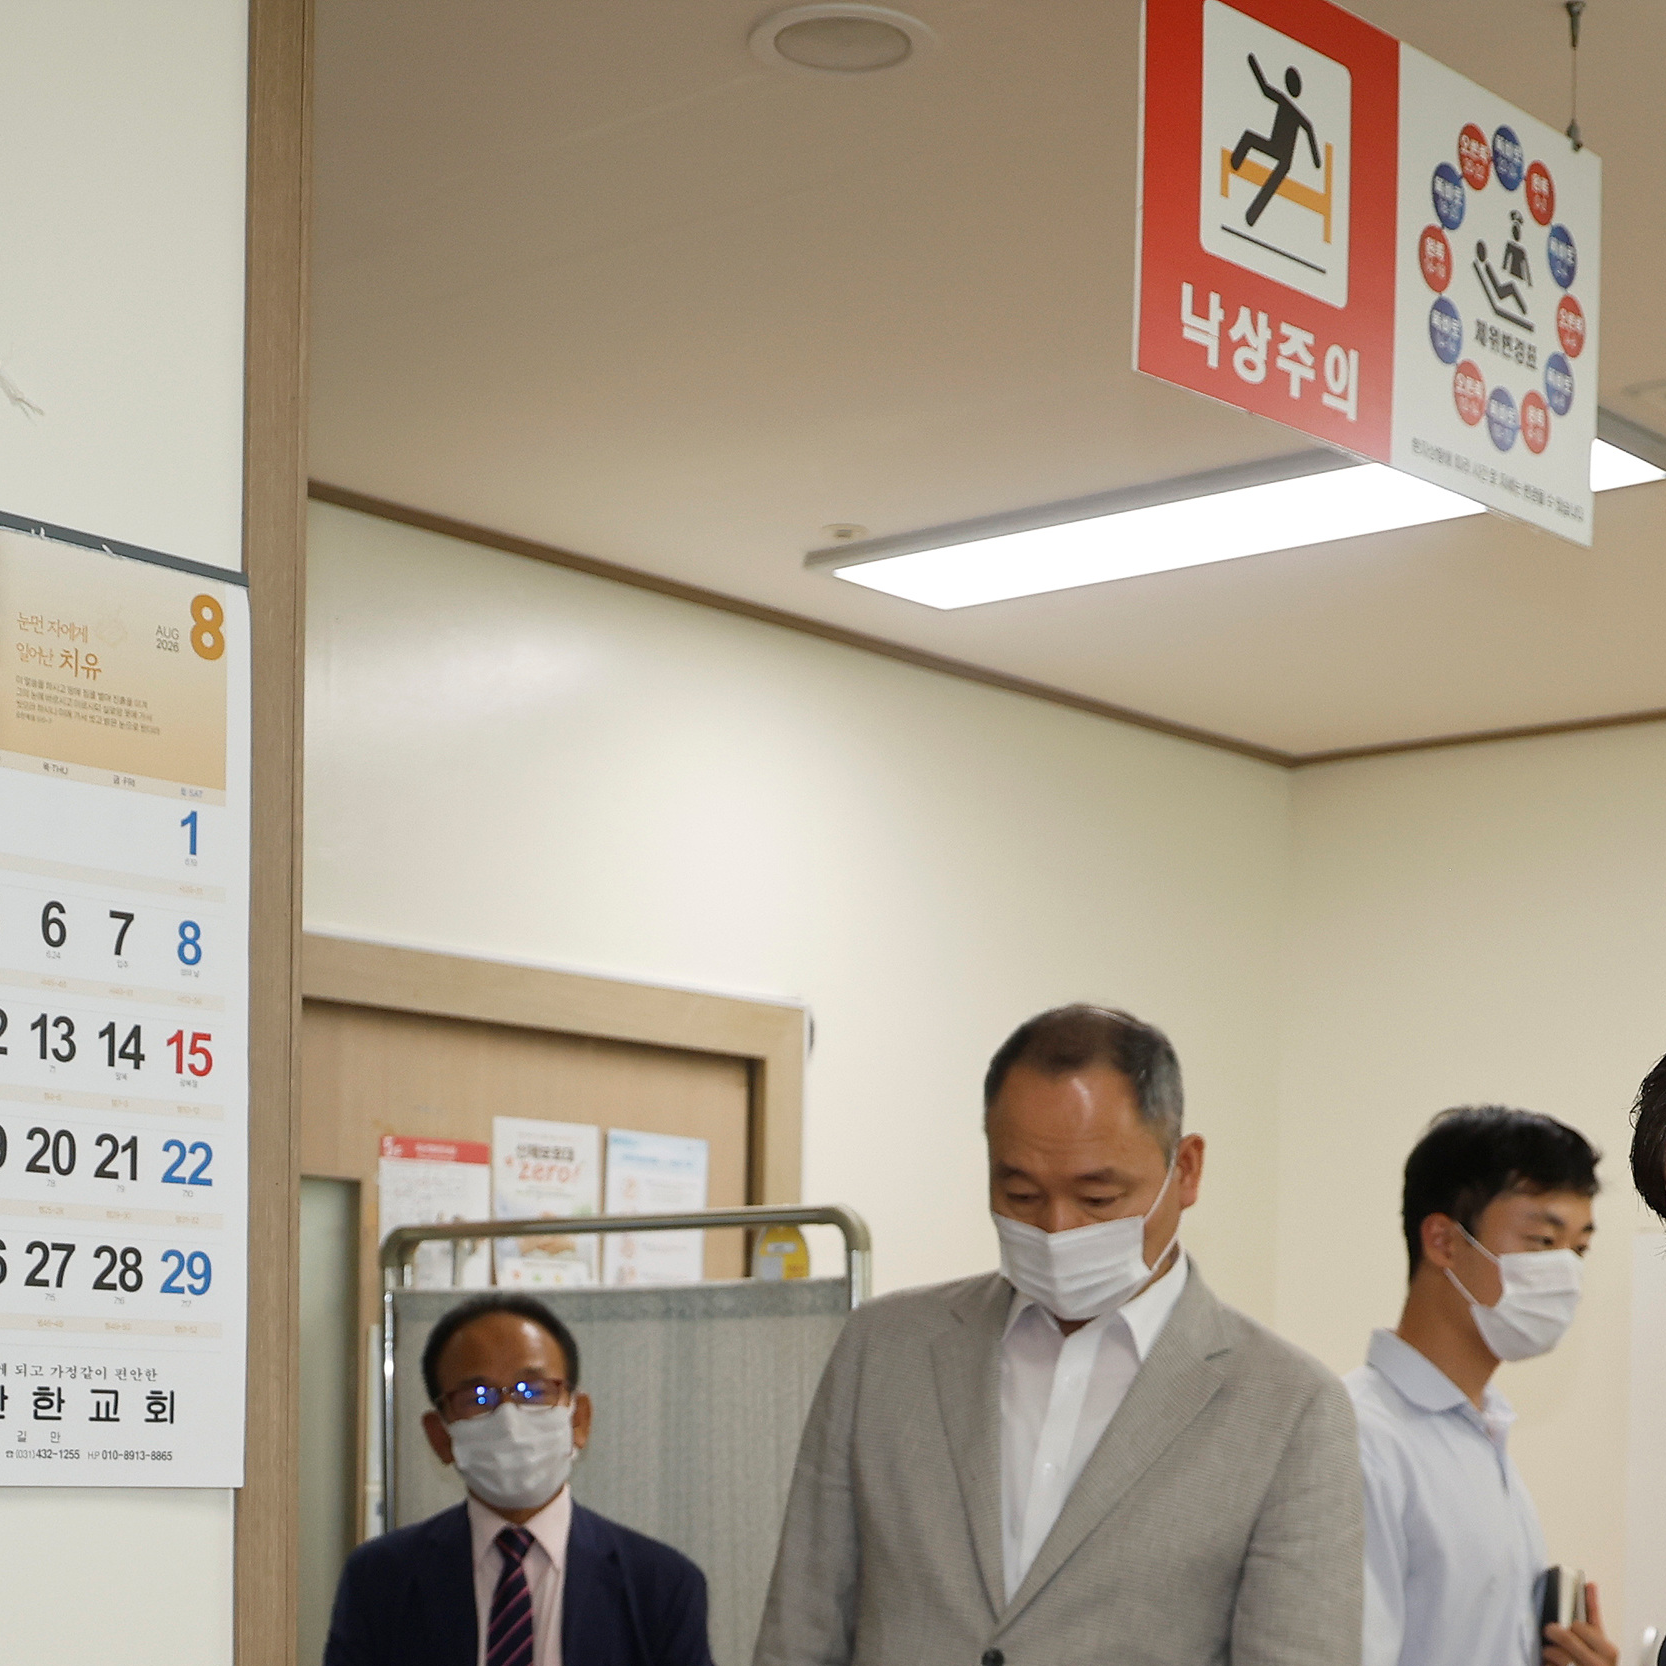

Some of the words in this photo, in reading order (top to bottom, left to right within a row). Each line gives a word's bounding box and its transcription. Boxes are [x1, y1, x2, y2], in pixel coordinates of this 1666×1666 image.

[1179, 281, 1360, 422] 낙상주의
[16, 611, 45, 636] 눈먼
[46, 618, 89, 645] 자에게
[155, 624, 180, 642] AUG
[156, 638, 180, 654] 2026
[191, 594, 225, 661] 8
[15, 642, 55, 669] 일어난
[58, 647, 103, 682] 치유
[180, 810, 198, 856] 1
[41, 900, 67, 948] 6
[109, 909, 135, 957] 7
[177, 920, 203, 966] 8
[30, 1012, 77, 1063] 13
[98, 1021, 146, 1071] 14
[166, 1029, 213, 1077] 15
[24, 1126, 77, 1177] 20
[93, 1132, 138, 1182] 21
[160, 1139, 213, 1187] 22
[23, 1240, 76, 1289] 27
[91, 1244, 144, 1293] 28
[159, 1249, 212, 1296] 29
[14, 1362, 44, 1378] 되고
[50, 1364, 107, 1381] 가정같이
[114, 1366, 158, 1383] 편안한
[102, 1450, 172, 1461] 010-8913-8865
